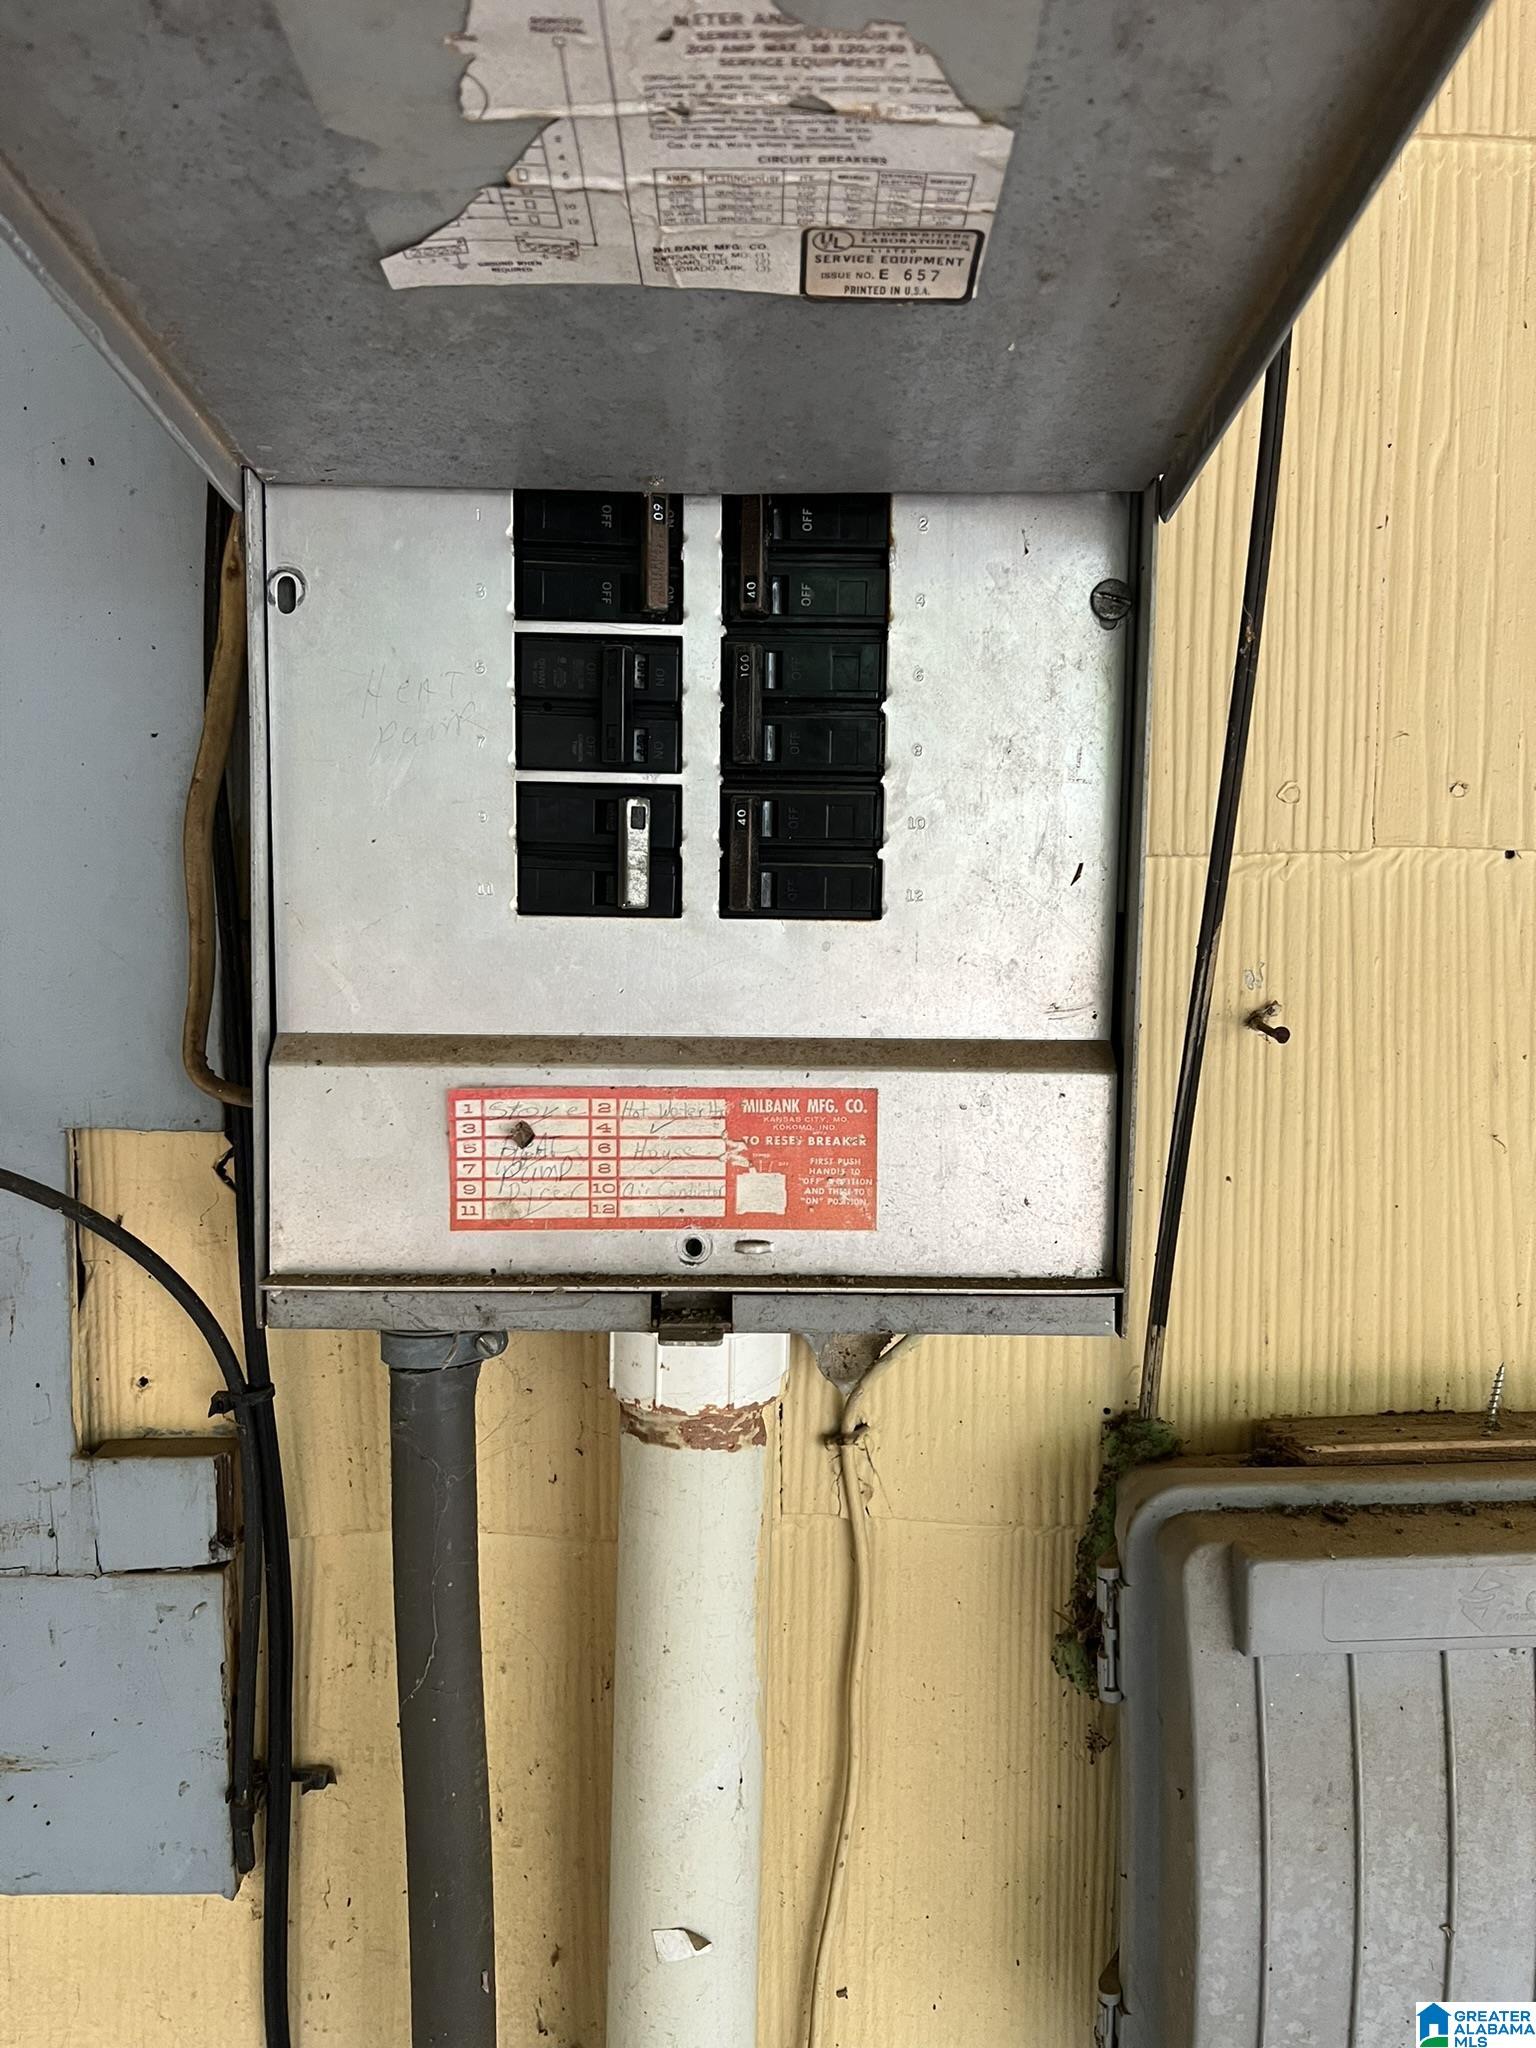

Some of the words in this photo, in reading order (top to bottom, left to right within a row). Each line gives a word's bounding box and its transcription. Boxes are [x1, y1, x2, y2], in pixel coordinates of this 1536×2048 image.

[672, 12, 743, 27] METER
[719, 57, 784, 67] SERVICE
[791, 57, 887, 69] EQUIPMENT
[757, 155, 812, 164] CIRCUIT
[817, 156, 888, 166] BREAKERS
[815, 254, 874, 265] SERVICE
[881, 255, 965, 267] EQUIPMENT
[820, 272, 850, 280] ISSUE
[855, 272, 875, 280] NO.
[879, 269, 889, 280] E
[844, 285, 887, 295] PRINTED
[890, 286, 901, 295] IN
[904, 286, 931, 296] U.S.A.
[601, 503, 613, 529] OFF
[652, 502, 664, 521] 60
[801, 507, 813, 532] OFF
[918, 517, 929, 532] 2
[475, 583, 486, 599] 3
[601, 581, 613, 606] OFF
[746, 581, 757, 599] 40
[800, 582, 812, 607] OFF
[915, 592, 926, 607] 4
[738, 653, 750, 680] 100
[654, 664, 665, 687] ON
[913, 666, 924, 682] 6
[654, 740, 665, 760] ON
[736, 809, 747, 827] 40
[907, 815, 926, 830] 10
[477, 881, 494, 896] 11
[906, 887, 924, 901] 12
[463, 1104, 473, 1114] 1
[486, 1101, 587, 1120] Stove
[597, 1103, 611, 1114] 2
[621, 1100, 649, 1120] Hot
[742, 1099, 800, 1114] MILBANK
[806, 1099, 839, 1114] MFG.
[845, 1099, 868, 1114] CO.
[462, 1123, 476, 1134] 3
[596, 1123, 612, 1133] 4
[597, 1142, 611, 1154] 6
[743, 1135, 759, 1146] TO
[807, 1135, 867, 1147] BREAKER
[463, 1143, 477, 1154] 5
[463, 1163, 476, 1174] 7
[597, 1163, 611, 1174] 8
[809, 1157, 833, 1166] FIRST
[837, 1157, 861, 1166] PUSH
[463, 1184, 477, 1195] 9
[592, 1183, 615, 1194] 10
[803, 1188, 825, 1196] AND
[854, 1188, 865, 1196] TO
[461, 1205, 478, 1216] 11
[592, 1204, 615, 1214] 12
